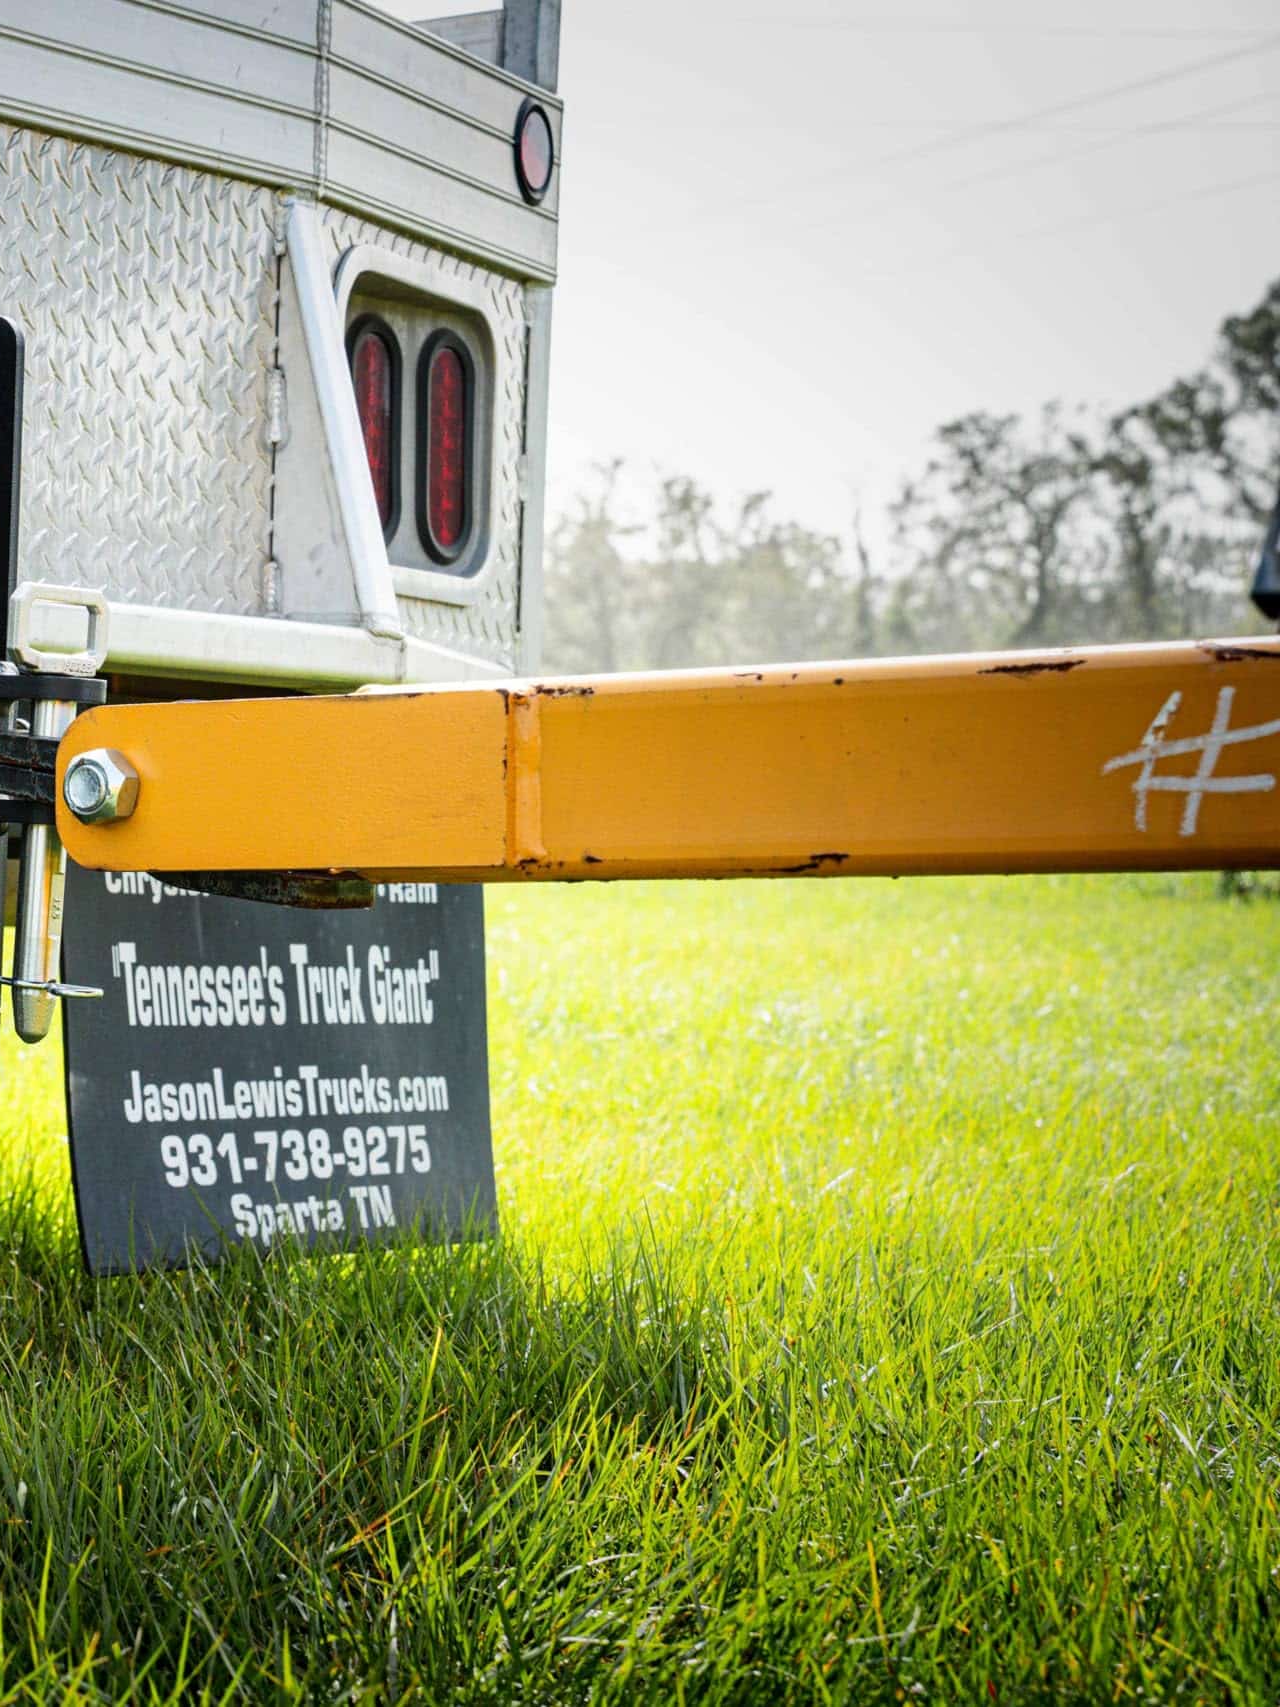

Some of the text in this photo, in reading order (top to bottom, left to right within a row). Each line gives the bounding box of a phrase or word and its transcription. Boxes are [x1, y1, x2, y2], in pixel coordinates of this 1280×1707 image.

[112, 941, 439, 1027] "Tennessee's Truck Giant"
[124, 1065, 448, 1124] JasonLewisTrucks.com
[160, 1125, 432, 1188] 931-738-9275
[231, 1185, 395, 1246] Sparta TN
